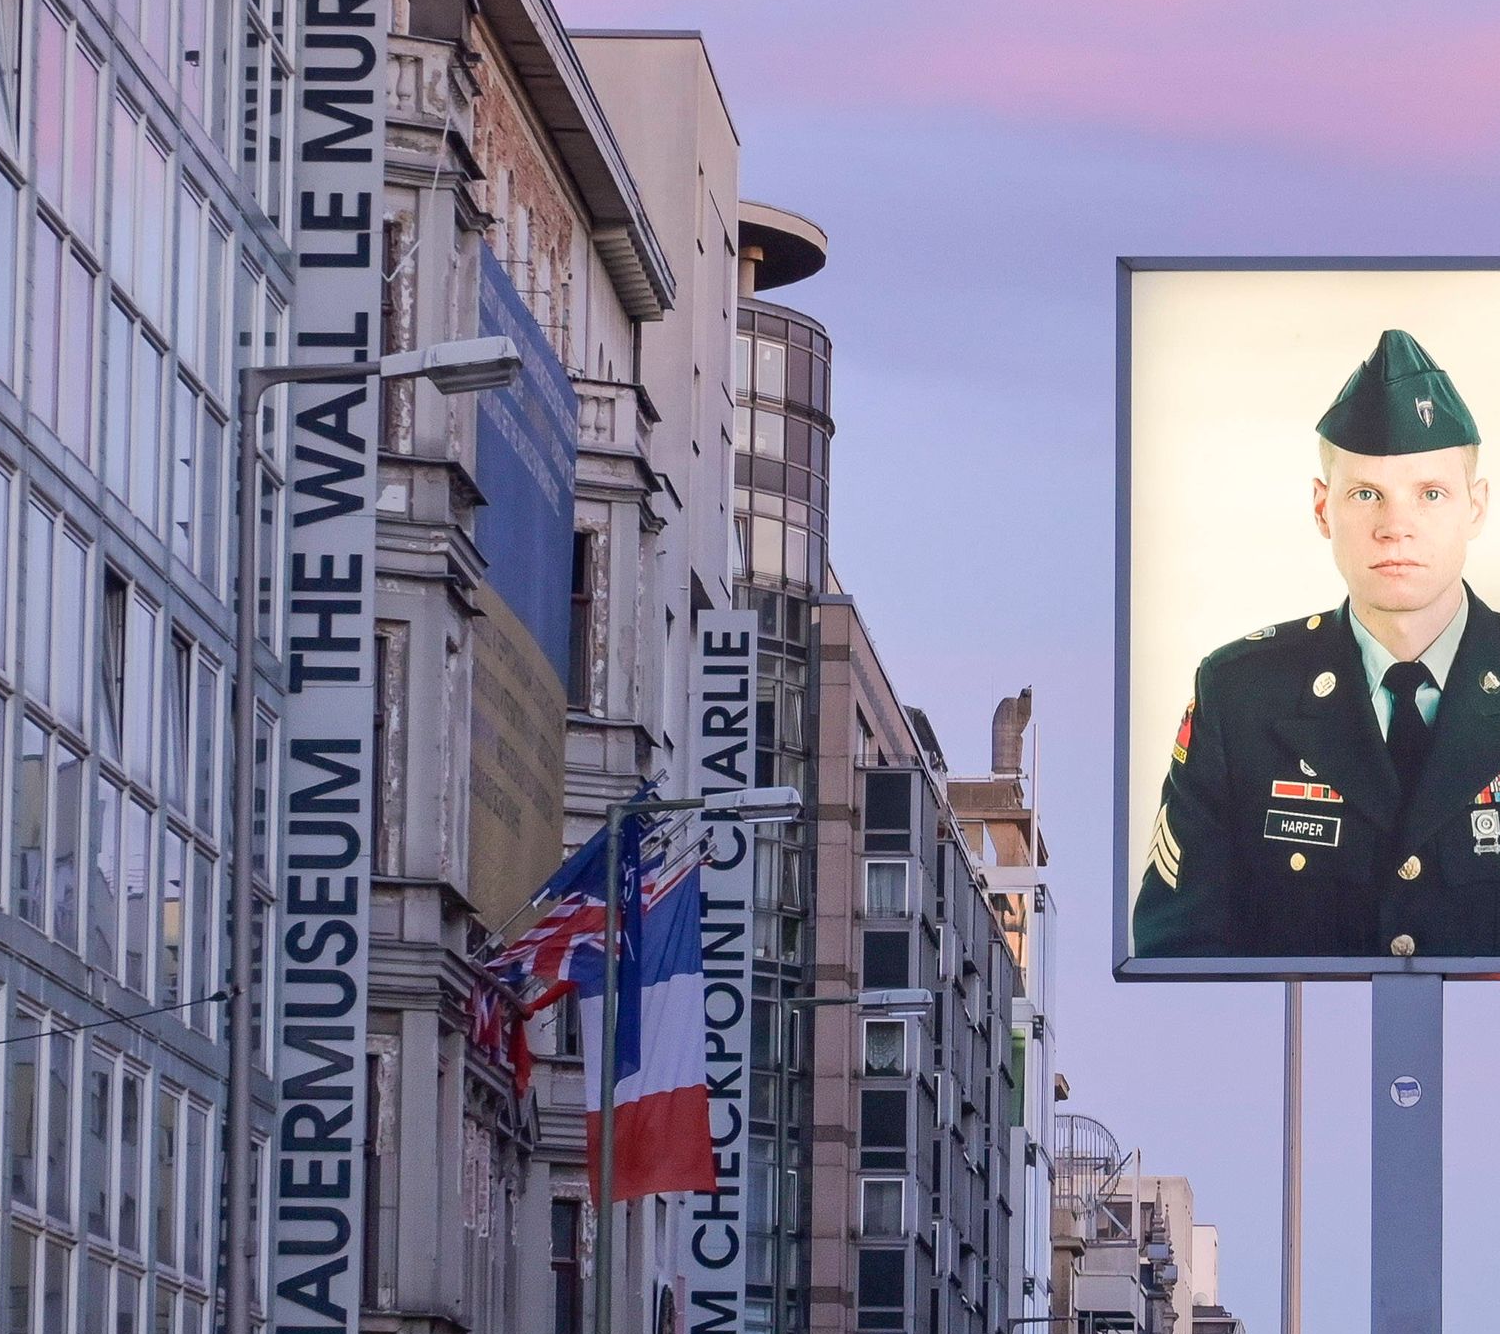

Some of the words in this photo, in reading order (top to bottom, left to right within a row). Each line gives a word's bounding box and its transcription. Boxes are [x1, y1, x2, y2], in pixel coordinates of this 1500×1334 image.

[299, 192, 371, 268] LE
[294, 312, 368, 527] WALL
[289, 552, 362, 693] THE
[699, 630, 749, 871] CHARLIE
[1280, 819, 1324, 837] HARPER
[691, 898, 747, 1270] CHECKPOINT
